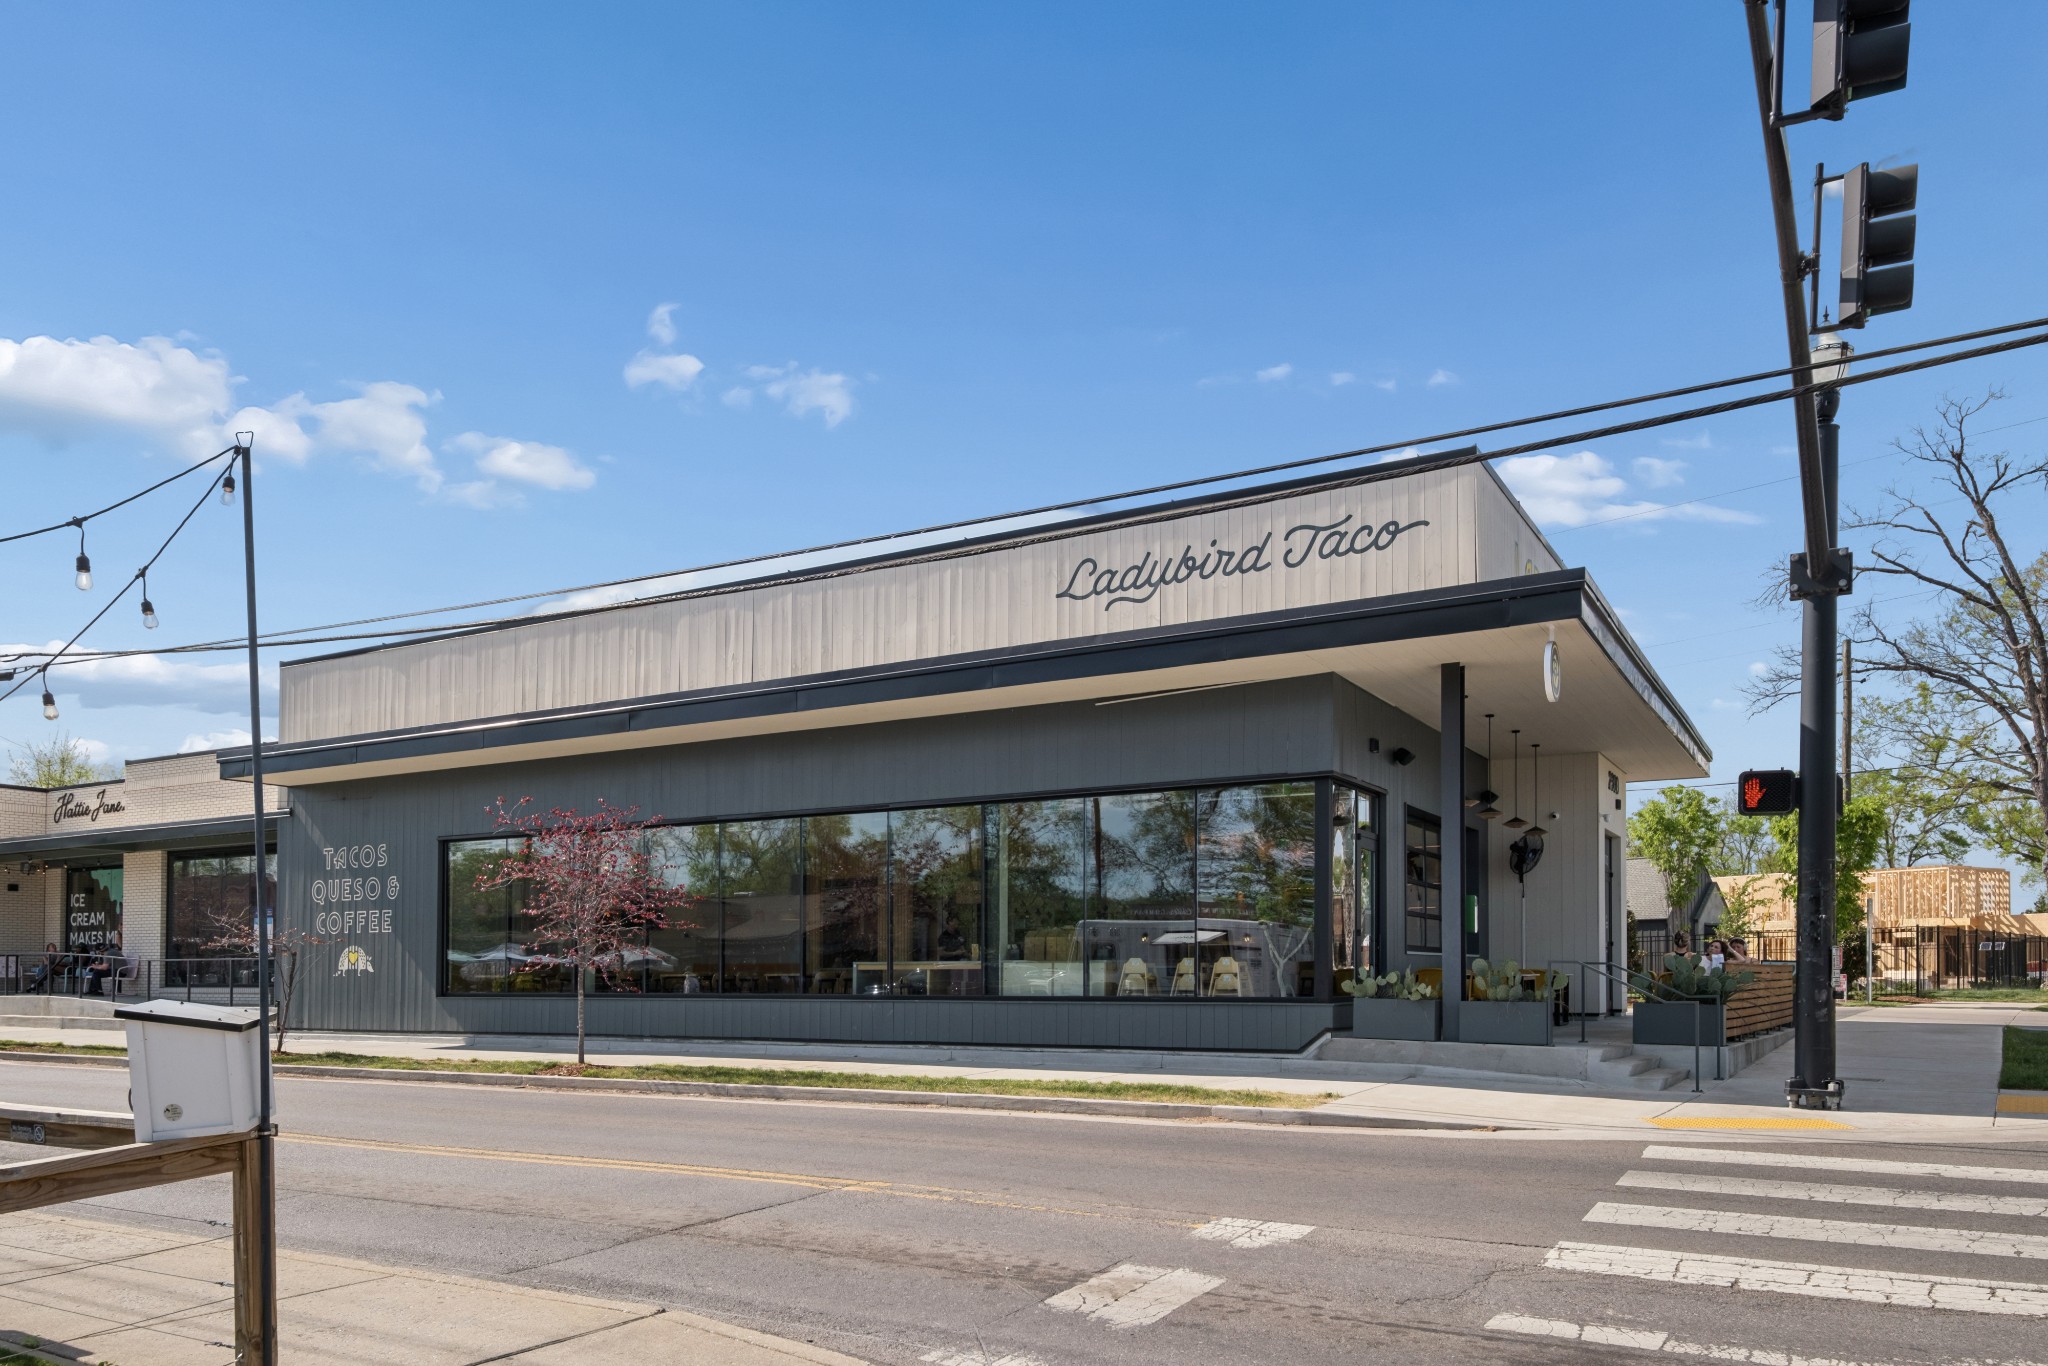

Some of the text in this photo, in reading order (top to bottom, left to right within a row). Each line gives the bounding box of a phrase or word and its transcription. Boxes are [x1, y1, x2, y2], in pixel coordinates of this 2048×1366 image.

[1056, 514, 1430, 611] Ladybird Taco
[54, 793, 91, 823] Hattie
[323, 844, 388, 870] TACOS
[70, 893, 86, 908] ICE
[311, 876, 400, 905] QUESO &
[70, 911, 105, 927] CREAM
[316, 910, 392, 935] COFFEE
[69, 931, 104, 946] MAKES
